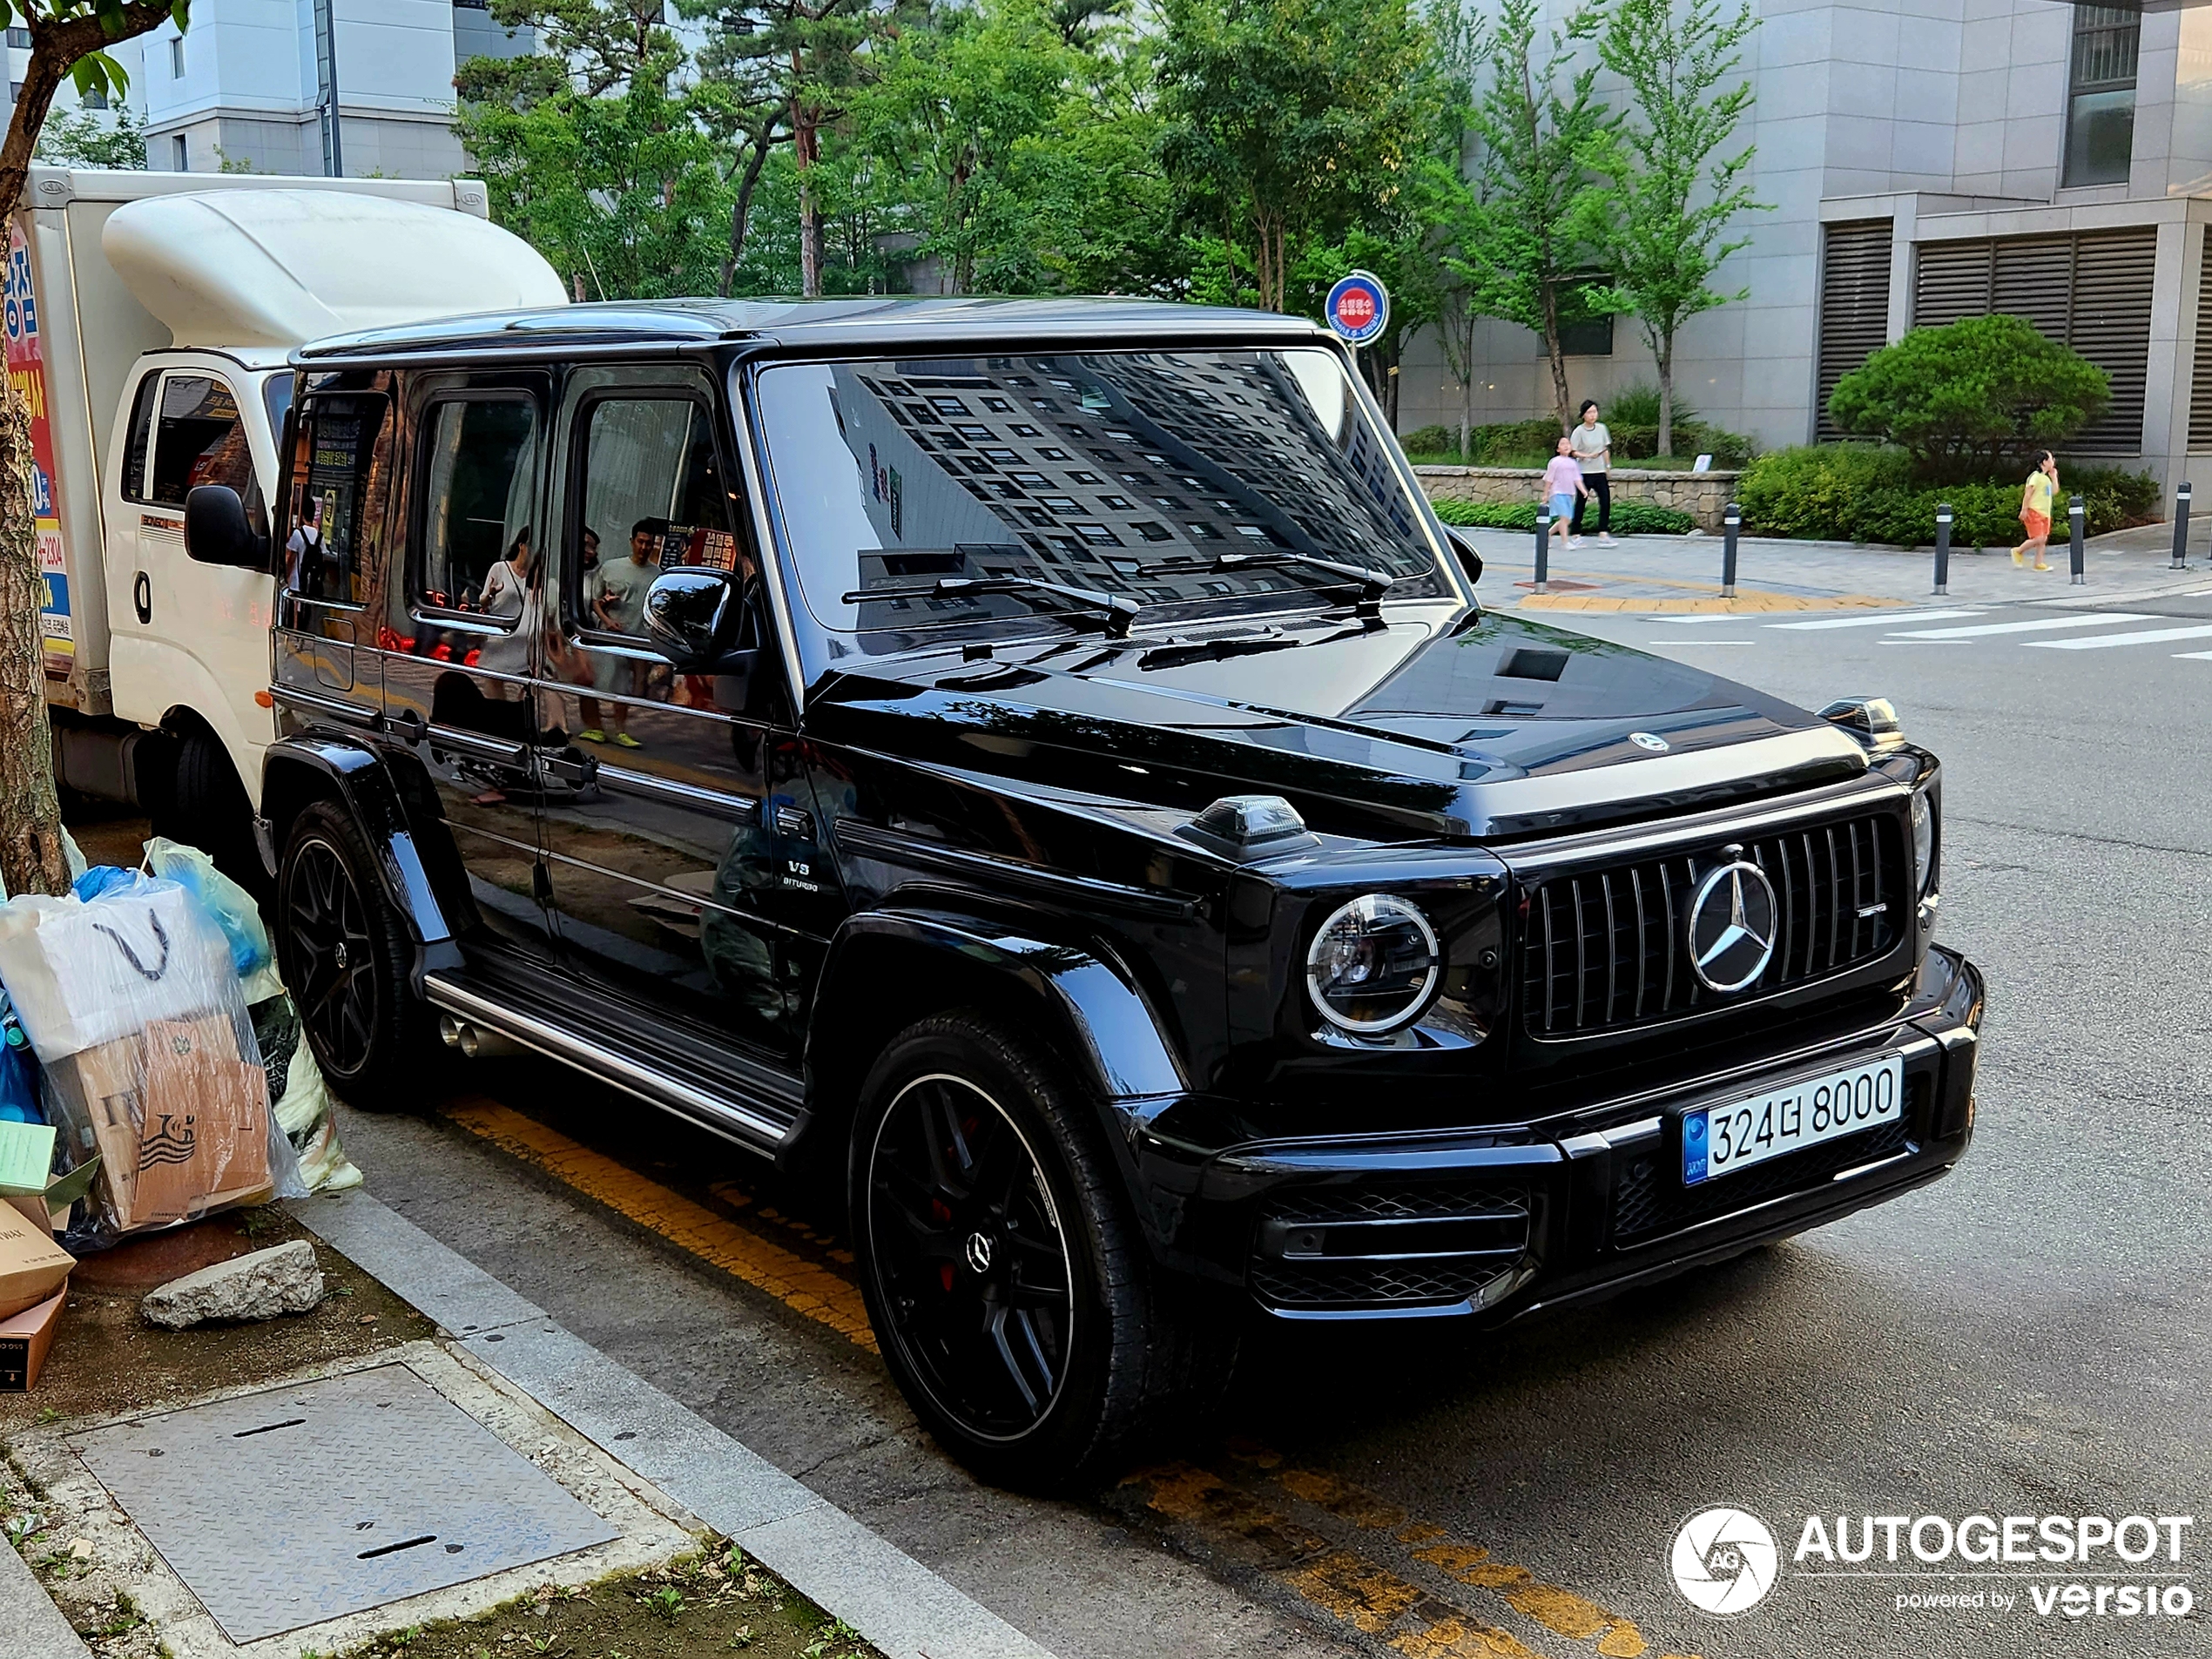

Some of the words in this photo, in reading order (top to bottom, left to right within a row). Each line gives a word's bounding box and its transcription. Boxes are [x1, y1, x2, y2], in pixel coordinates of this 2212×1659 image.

[788, 860, 810, 876] V8
[783, 877, 819, 893] BITURBO
[1712, 1095, 1802, 1165] 324더
[1811, 1067, 1893, 1133] 8000
